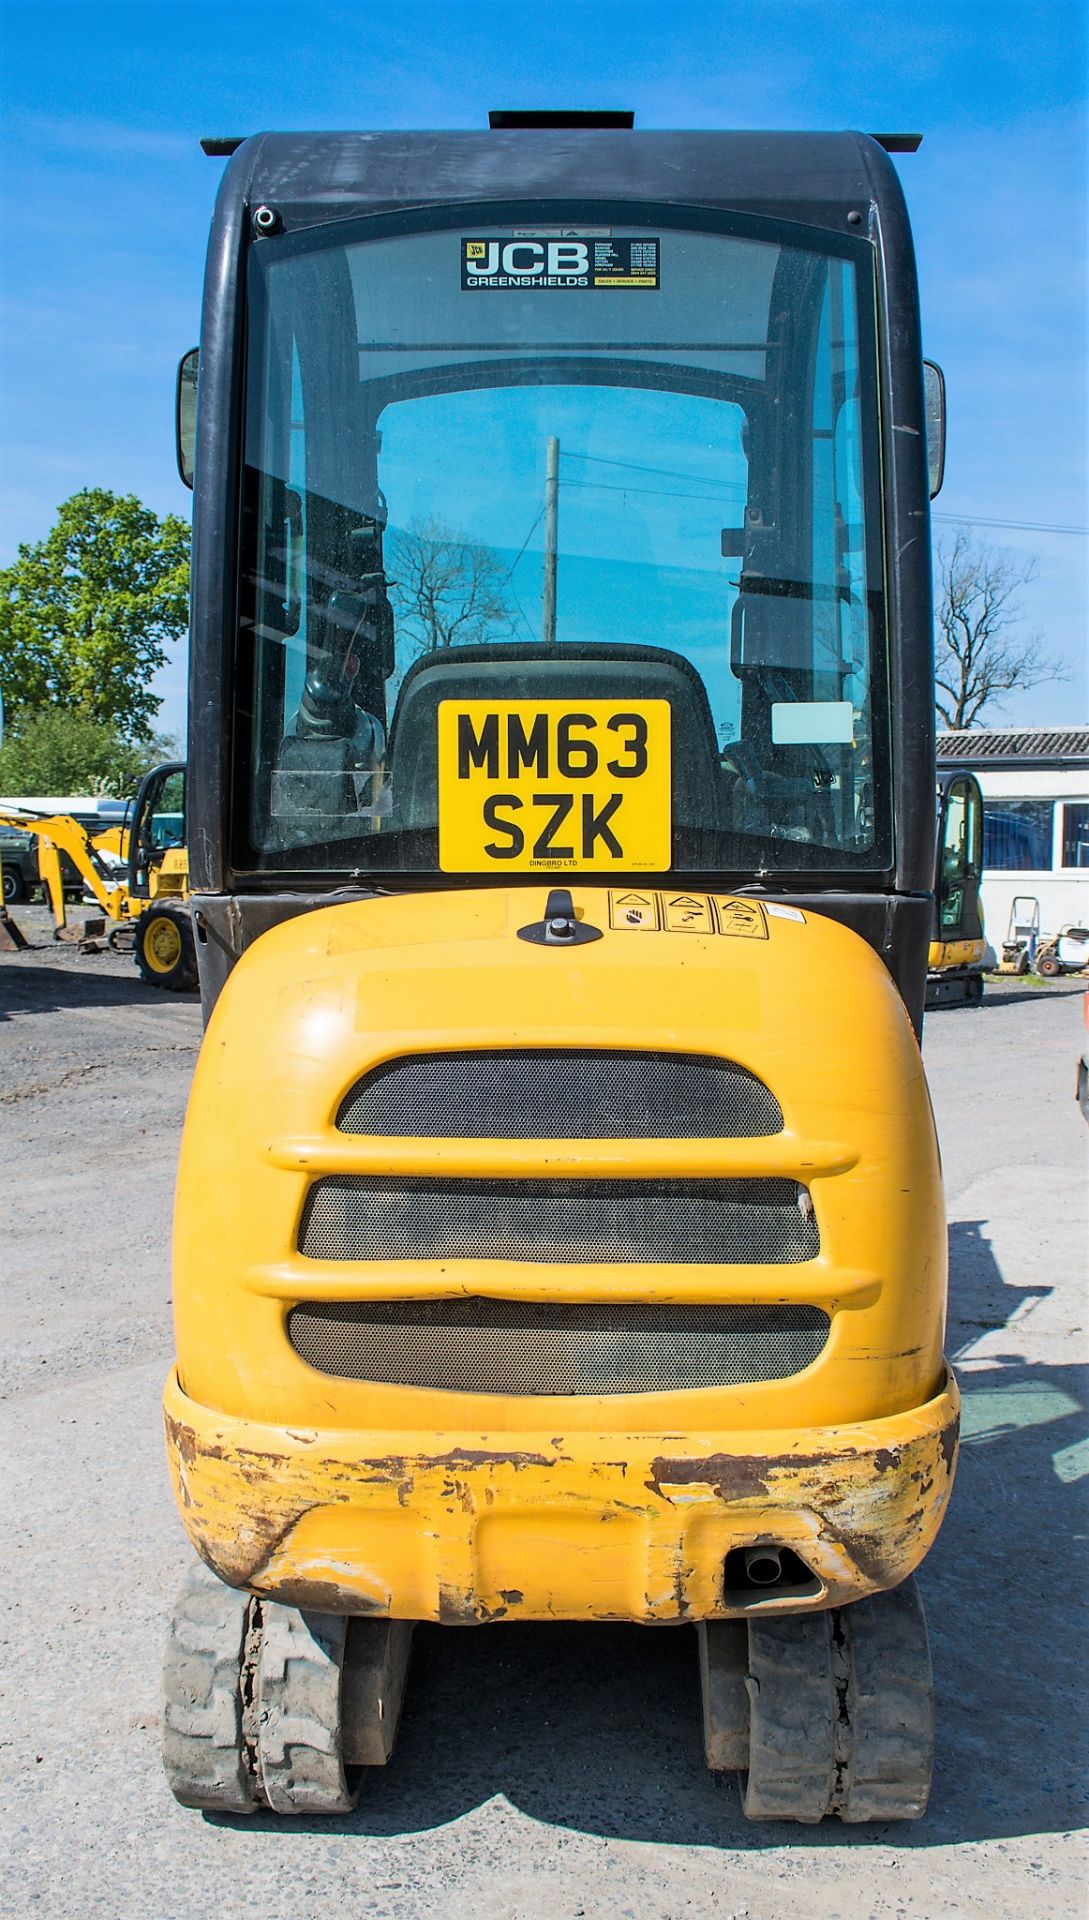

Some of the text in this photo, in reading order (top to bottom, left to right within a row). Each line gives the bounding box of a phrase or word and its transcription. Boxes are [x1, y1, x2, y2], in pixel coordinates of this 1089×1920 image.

[467, 242, 589, 276] JCB
[467, 277, 589, 287] GREENSHIELDS
[458, 713, 648, 779] MM63
[483, 794, 624, 859] SZK
